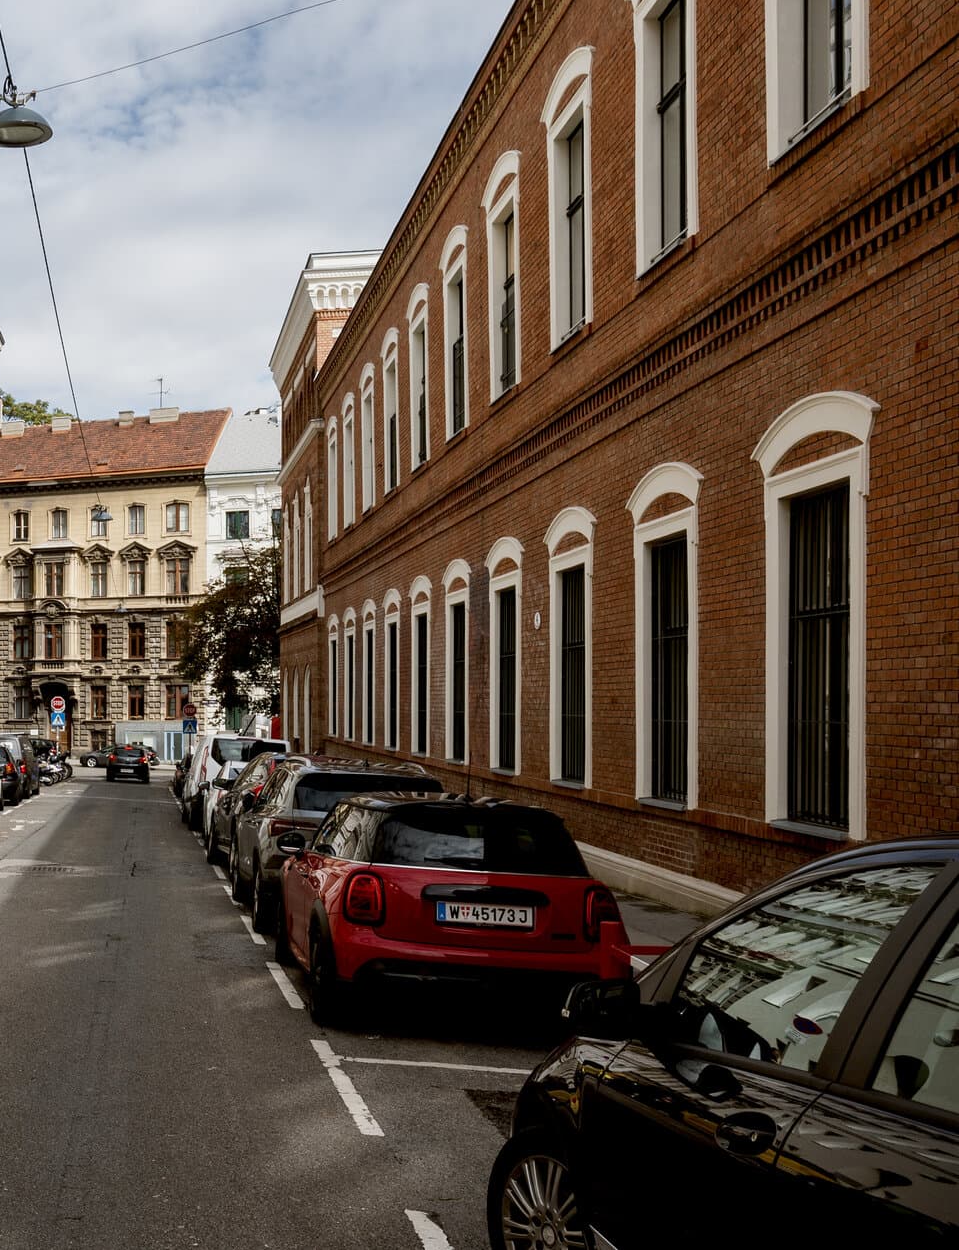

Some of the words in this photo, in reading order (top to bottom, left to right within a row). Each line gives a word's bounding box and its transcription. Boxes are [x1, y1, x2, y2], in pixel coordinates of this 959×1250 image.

[449, 905, 460, 919] W
[471, 906, 516, 923] 45173
[518, 909, 528, 924] J
